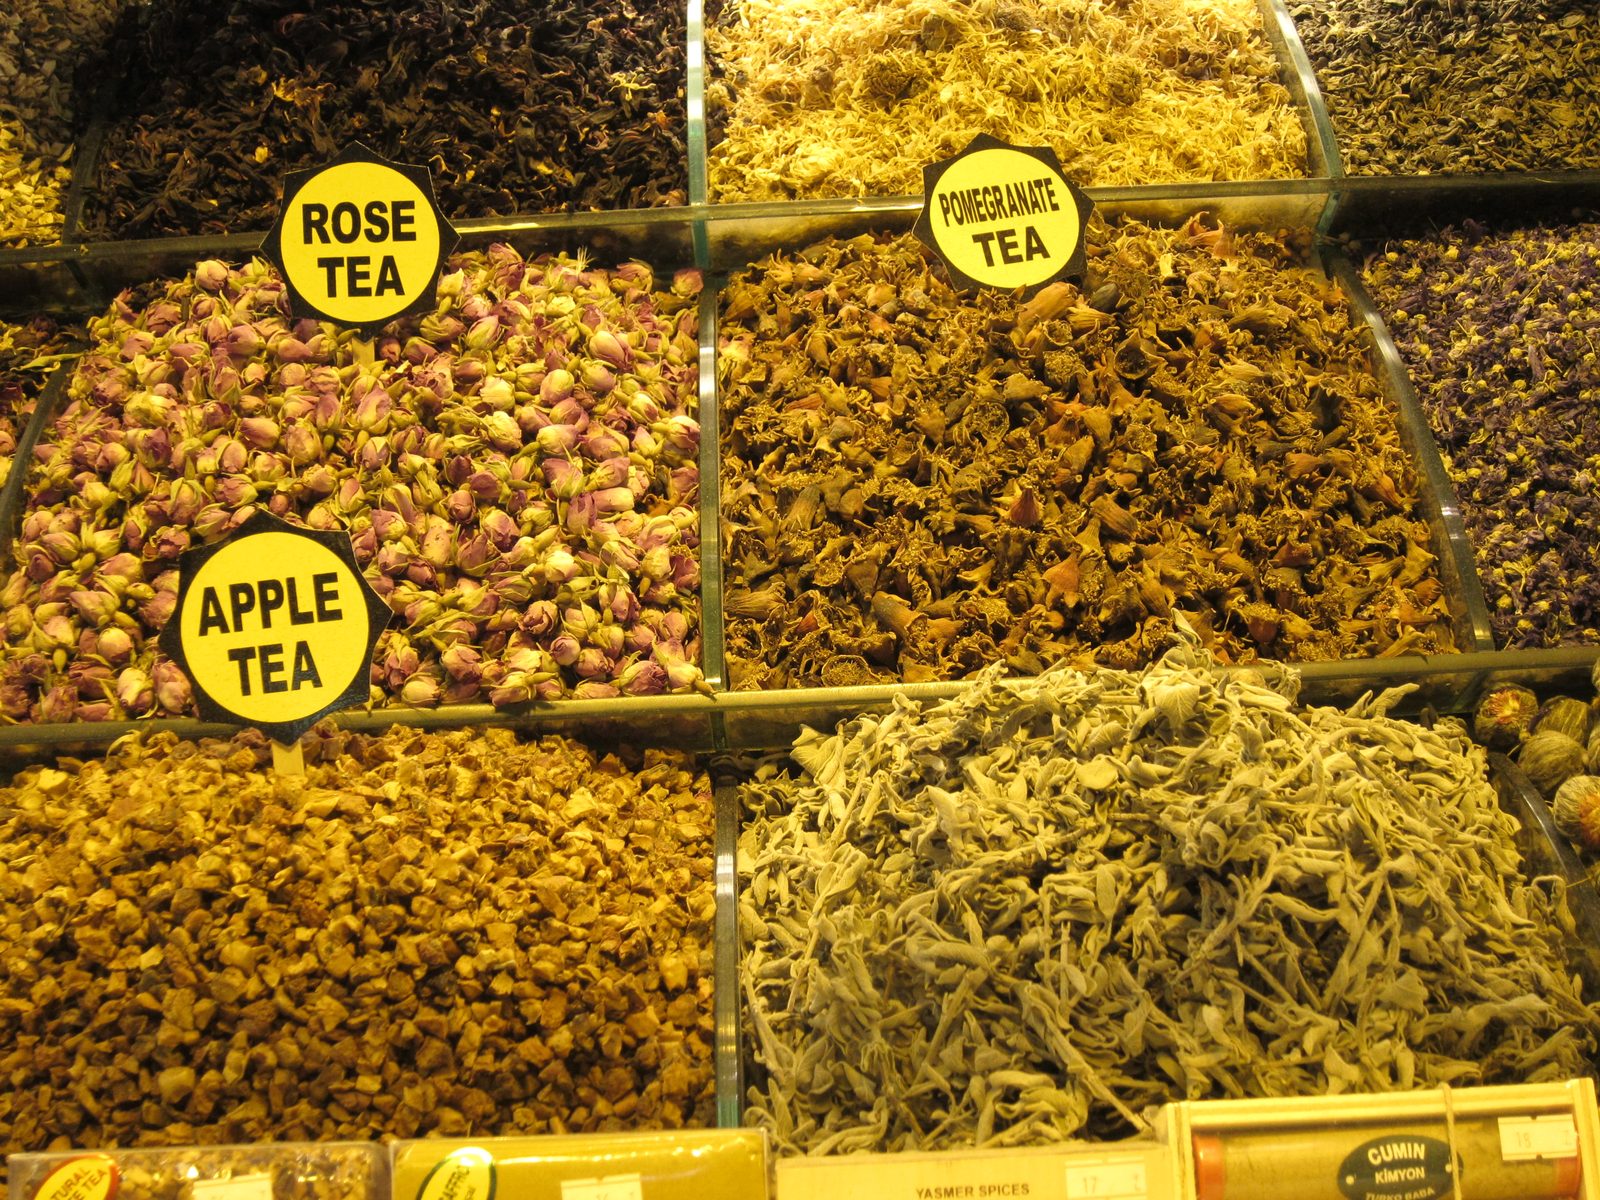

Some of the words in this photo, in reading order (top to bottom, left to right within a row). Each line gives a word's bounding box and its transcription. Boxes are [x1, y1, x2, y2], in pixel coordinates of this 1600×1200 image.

[302, 200, 417, 245] ROSE
[938, 177, 1060, 228] POMEGRANATE
[971, 225, 1051, 268] TEA
[317, 255, 406, 298] TEA
[198, 571, 343, 637] APPLE
[227, 640, 323, 697] TEA
[1367, 1141, 1426, 1166] CUMIN
[50, 1167, 91, 1200] TURAL
[81, 1168, 107, 1192] TEA
[916, 1185, 974, 1200] YASMER
[978, 1183, 1030, 1198] SPICES
[1374, 1167, 1426, 1185] KİMYON
